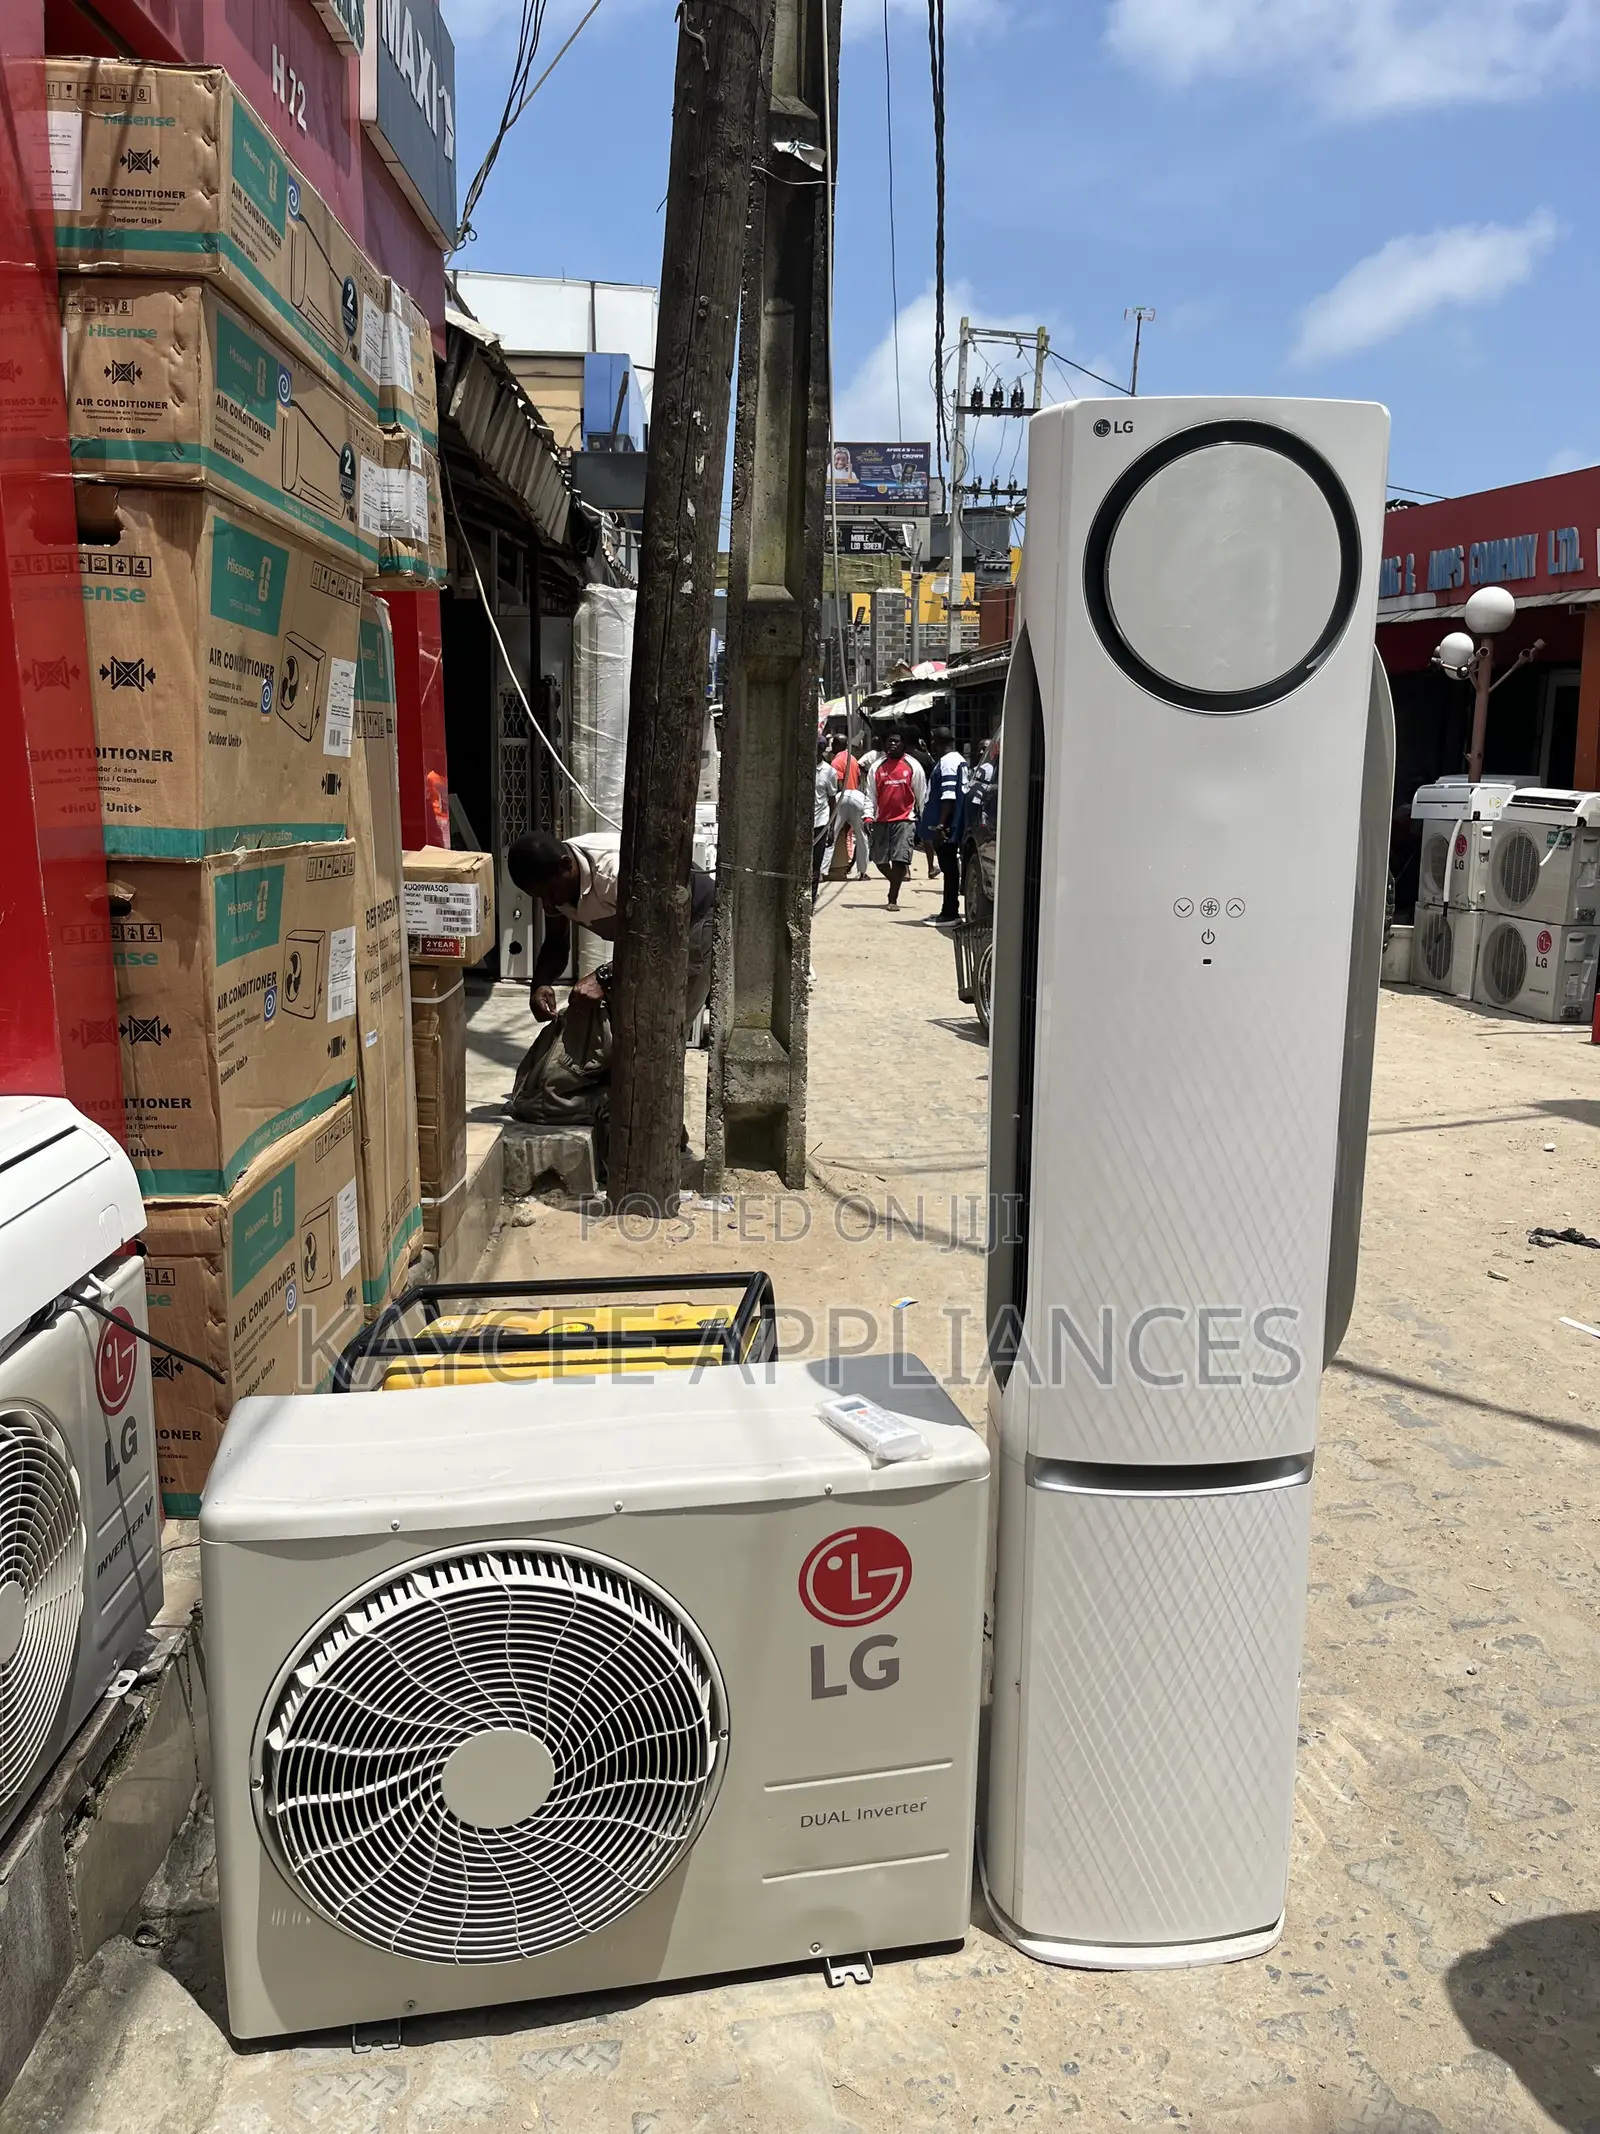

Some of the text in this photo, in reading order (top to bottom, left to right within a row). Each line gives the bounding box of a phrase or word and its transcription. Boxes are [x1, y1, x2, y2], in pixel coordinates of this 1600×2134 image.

[272, 43, 285, 104] H
[90, 187, 186, 199] AIR CONDITIONER
[114, 216, 139, 224] Indoor
[231, 184, 242, 202] AIR
[243, 195, 282, 250] CONDITIONER
[346, 283, 354, 311] 2
[88, 324, 158, 339] Hisense
[76, 398, 168, 410] AIR CONDITIONER
[216, 393, 228, 412] AIR
[229, 402, 271, 442] CONDITIONER
[1114, 420, 1134, 434] LG
[344, 450, 352, 475] 2
[137, 560, 145, 570] 4
[226, 556, 255, 582] Hisense
[1469, 533, 1539, 586] COMPANY
[208, 647, 275, 680] AIR CONDITIONER
[106, 802, 134, 813] Unit
[1454, 859, 1465, 871] LG
[147, 926, 156, 937] 4
[426, 940, 455, 948] 2 YEAR
[1535, 956, 1548, 969] LG
[217, 971, 277, 1012] AIR CONDITIONER
[130, 1149, 156, 1158] Unit
[161, 1270, 169, 1281] 4
[233, 1319, 247, 1342] AIR
[247, 1261, 297, 1326] CONDITIONER
[104, 1415, 139, 1487] LG
[97, 1495, 154, 1580] INVERTER V
[810, 1633, 899, 1701] LG
[800, 1799, 928, 1828] DUAL Inverter
